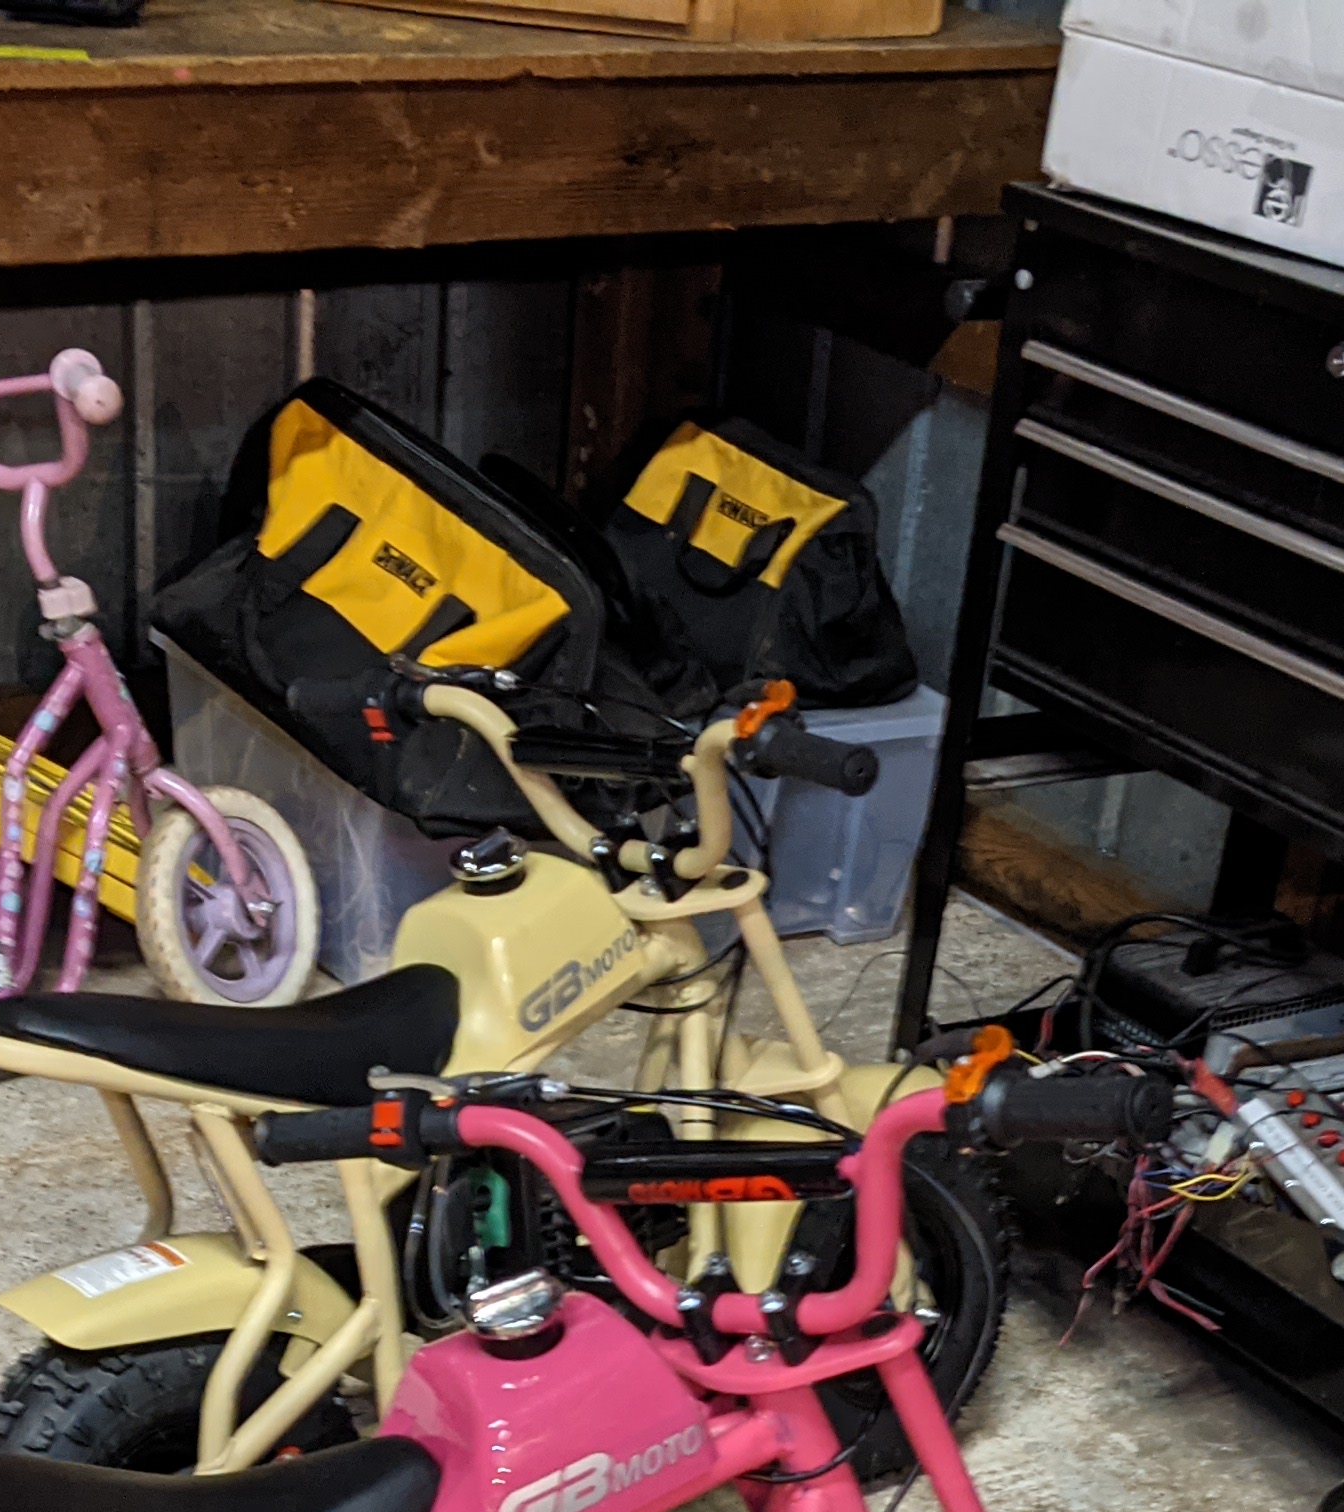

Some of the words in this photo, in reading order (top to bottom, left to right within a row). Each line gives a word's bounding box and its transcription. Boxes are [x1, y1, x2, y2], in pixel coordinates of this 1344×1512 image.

[519, 959, 584, 1032] GB
[582, 928, 636, 988] MOTO
[611, 1424, 704, 1494] MOTO
